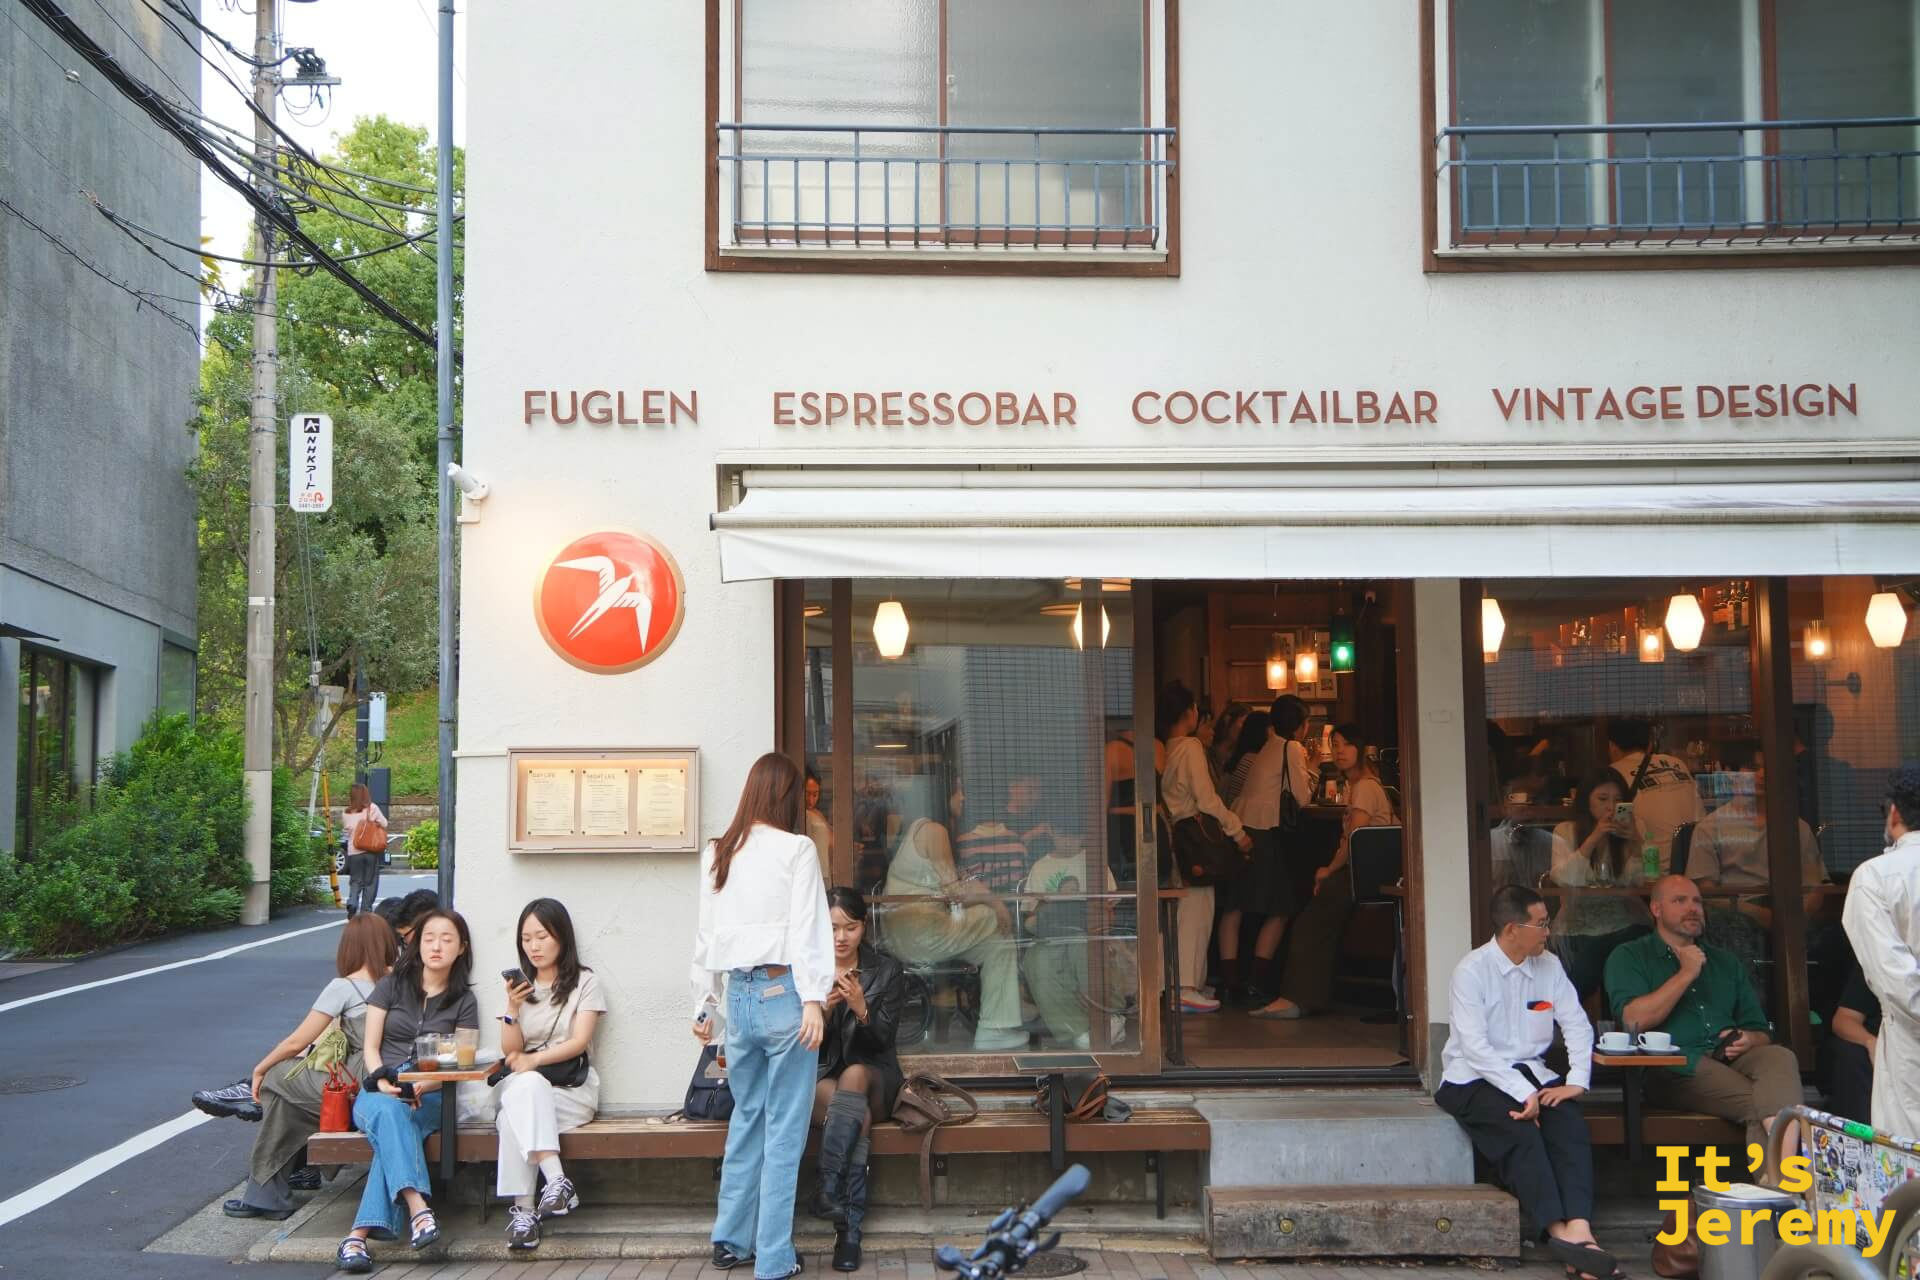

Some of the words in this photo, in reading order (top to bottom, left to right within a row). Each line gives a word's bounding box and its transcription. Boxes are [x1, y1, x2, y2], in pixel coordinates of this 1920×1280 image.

[525, 390, 698, 425] FUGLEN
[773, 391, 1077, 426] ESPRESSOBAR
[1131, 390, 1438, 425] COCKTAILBAR
[1492, 386, 1685, 421] VINTAGE
[1696, 383, 1859, 418] DESIGN
[306, 436, 317, 490] NHKアート
